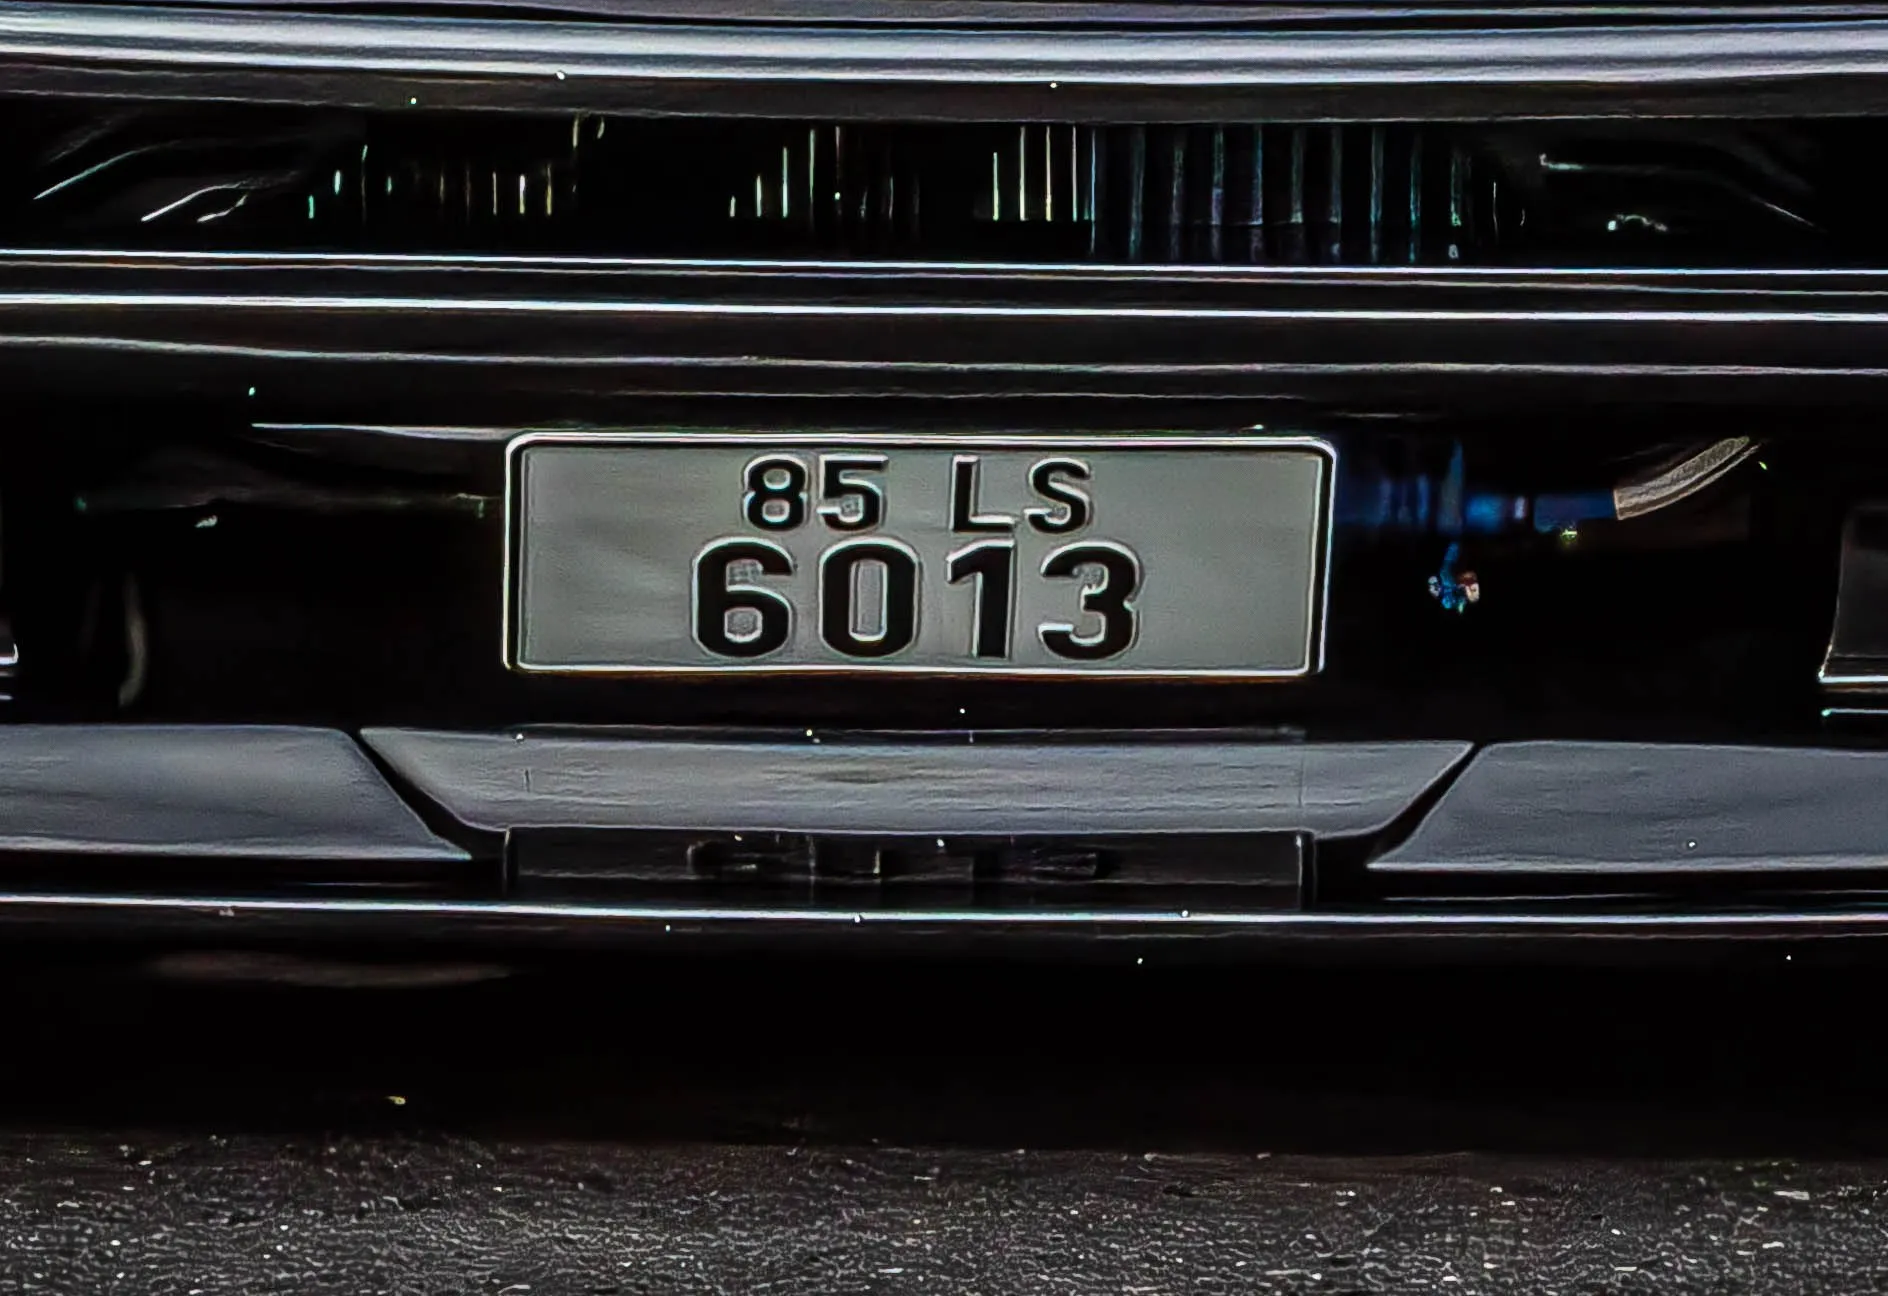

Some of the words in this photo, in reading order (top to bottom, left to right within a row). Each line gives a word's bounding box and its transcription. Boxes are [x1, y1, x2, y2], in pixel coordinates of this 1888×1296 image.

[743, 454, 889, 533] 85
[948, 454, 1093, 534] LS
[690, 535, 1142, 662] 6013
